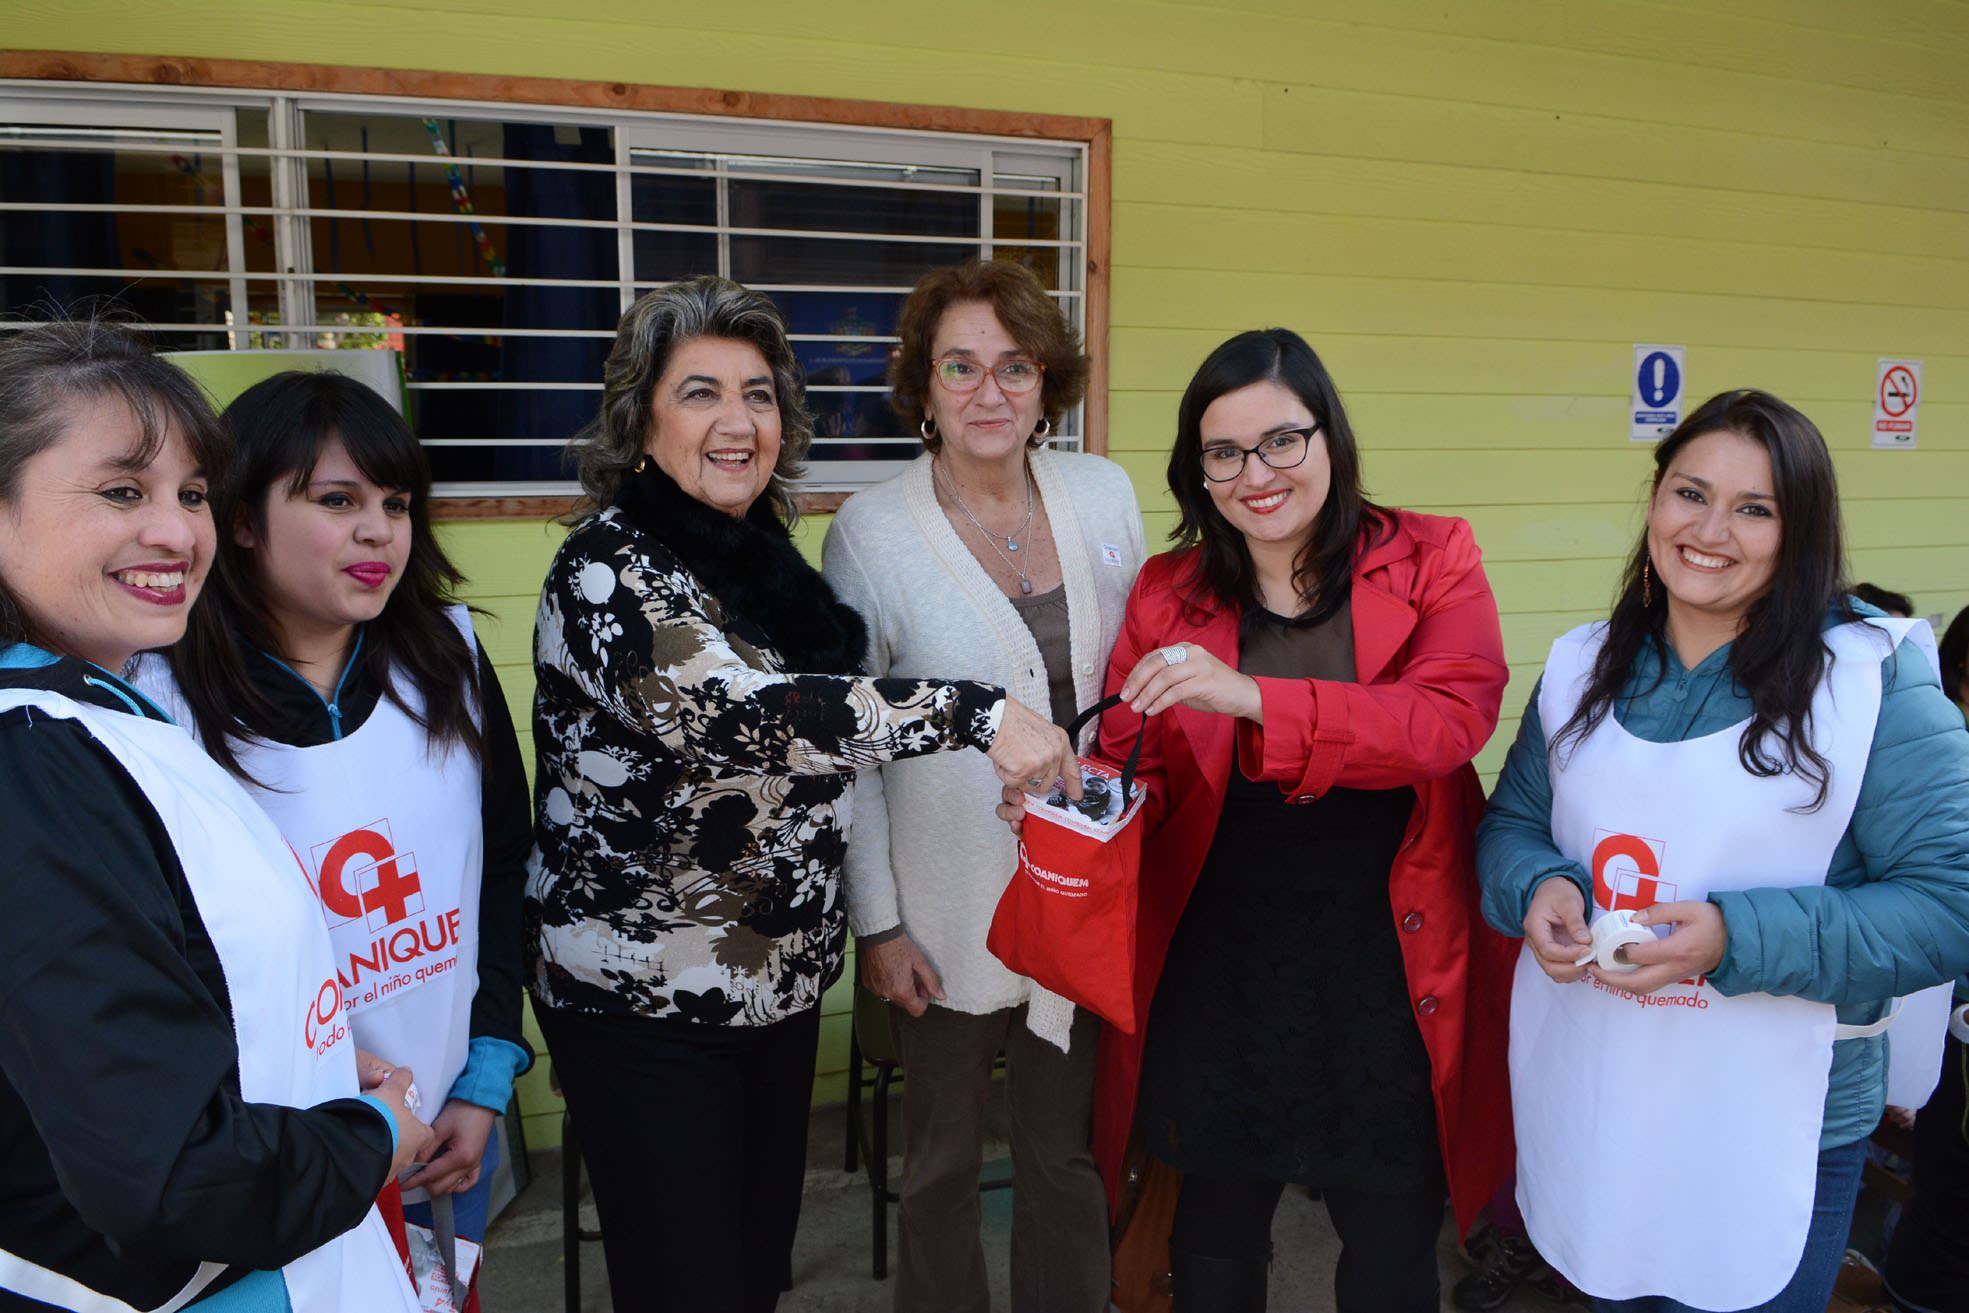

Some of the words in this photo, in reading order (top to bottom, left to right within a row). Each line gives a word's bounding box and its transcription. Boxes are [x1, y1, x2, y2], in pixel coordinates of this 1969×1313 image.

[1080, 763, 1110, 779] ECTA
[1030, 864, 1089, 887] COANIQUEM
[364, 982, 378, 1003] el
[381, 974, 412, 996] niño
[415, 956, 458, 984] quem
[1636, 991, 1709, 1009] quemado
